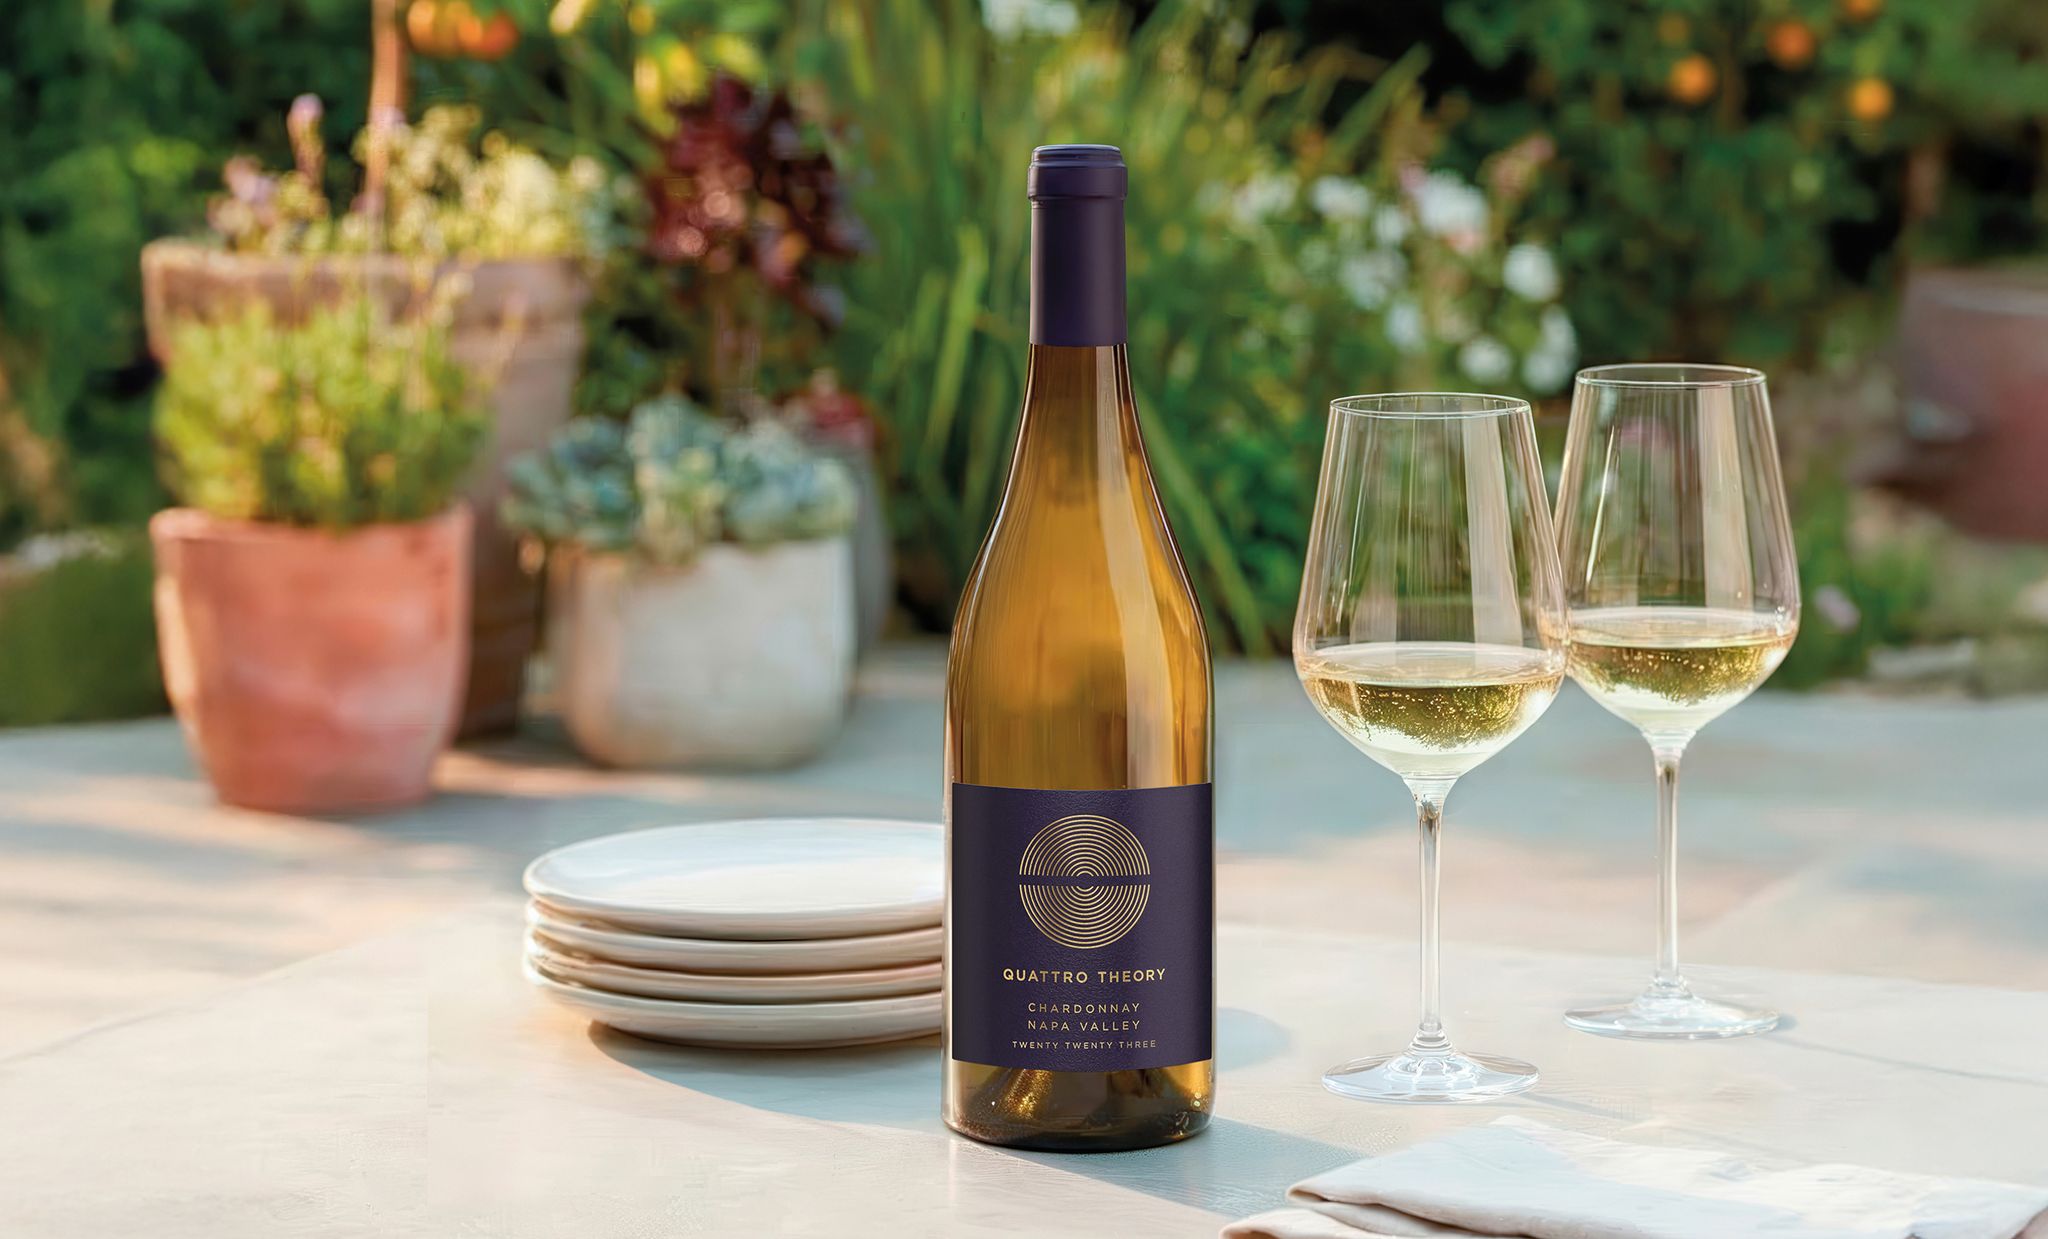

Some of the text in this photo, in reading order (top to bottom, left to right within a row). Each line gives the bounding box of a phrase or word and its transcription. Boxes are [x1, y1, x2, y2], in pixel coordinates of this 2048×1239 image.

[1003, 968, 1166, 984] QUATTRO THEORY
[1028, 1002, 1140, 1014] CHARDONNAY
[1027, 1020, 1141, 1032] NAPA VALLEY
[1012, 1039, 1157, 1050] TWENTY TWENTY THREE
